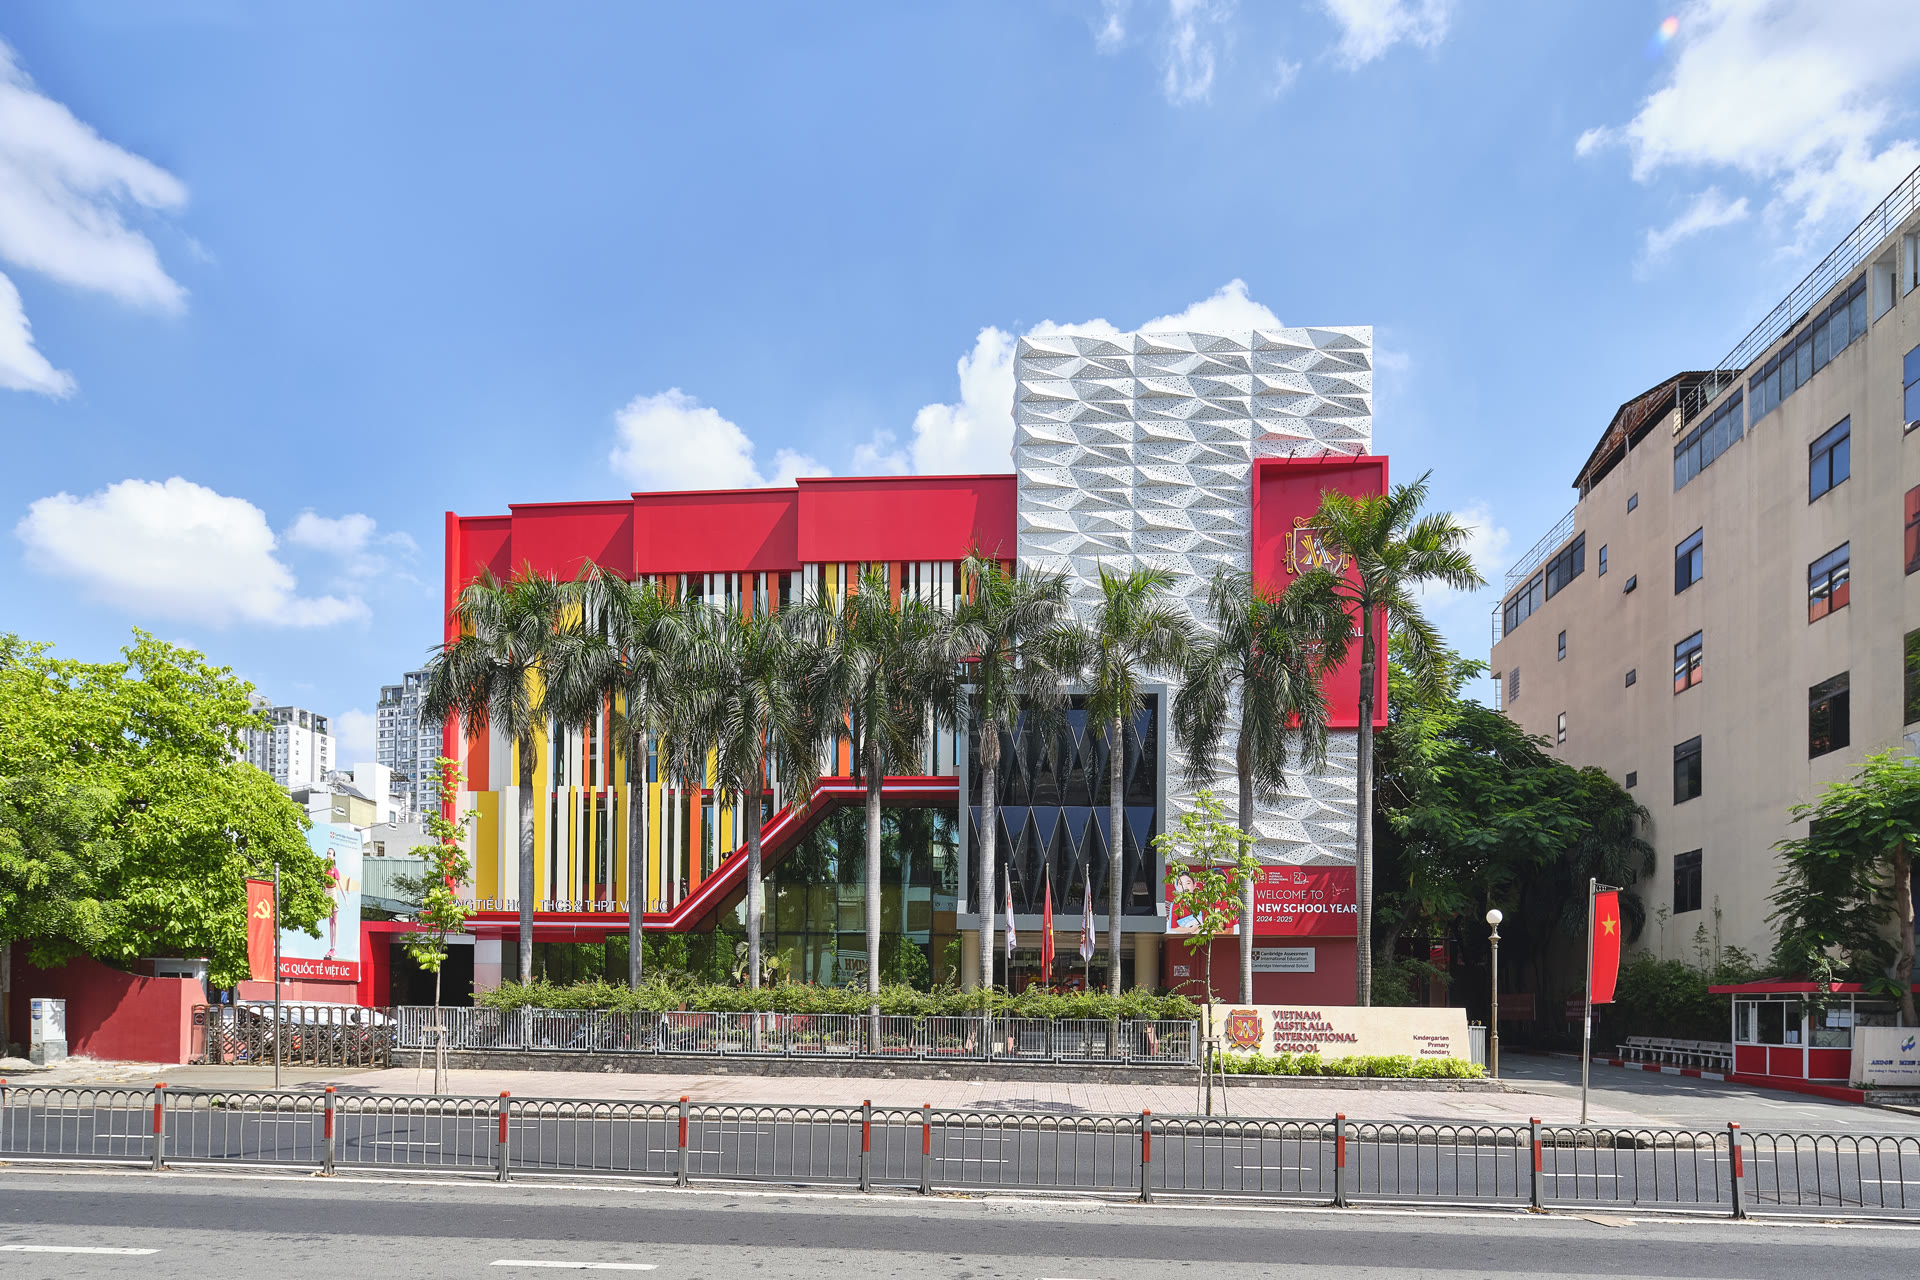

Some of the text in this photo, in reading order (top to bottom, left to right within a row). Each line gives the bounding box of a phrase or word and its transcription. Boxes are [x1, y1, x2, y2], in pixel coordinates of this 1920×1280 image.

[1256, 890, 1324, 900] WELCOME TO
[475, 894, 503, 911] TIỂU
[539, 899, 572, 912] THCS
[573, 900, 583, 912] &
[584, 900, 617, 912] THPT
[650, 898, 668, 912] ÚC
[1256, 903, 1357, 913] NEW SCHOOL YEAR
[291, 961, 314, 976] QUỐC
[315, 962, 324, 975] TẾ
[324, 964, 339, 977] VIỆT
[340, 965, 350, 976] ÚC
[1272, 1010, 1322, 1020] VIETNAM
[1273, 1021, 1334, 1031] AUSTRALIA
[1273, 1032, 1359, 1042] INTERNATIONAL
[1274, 1043, 1321, 1053] SCHOOL
